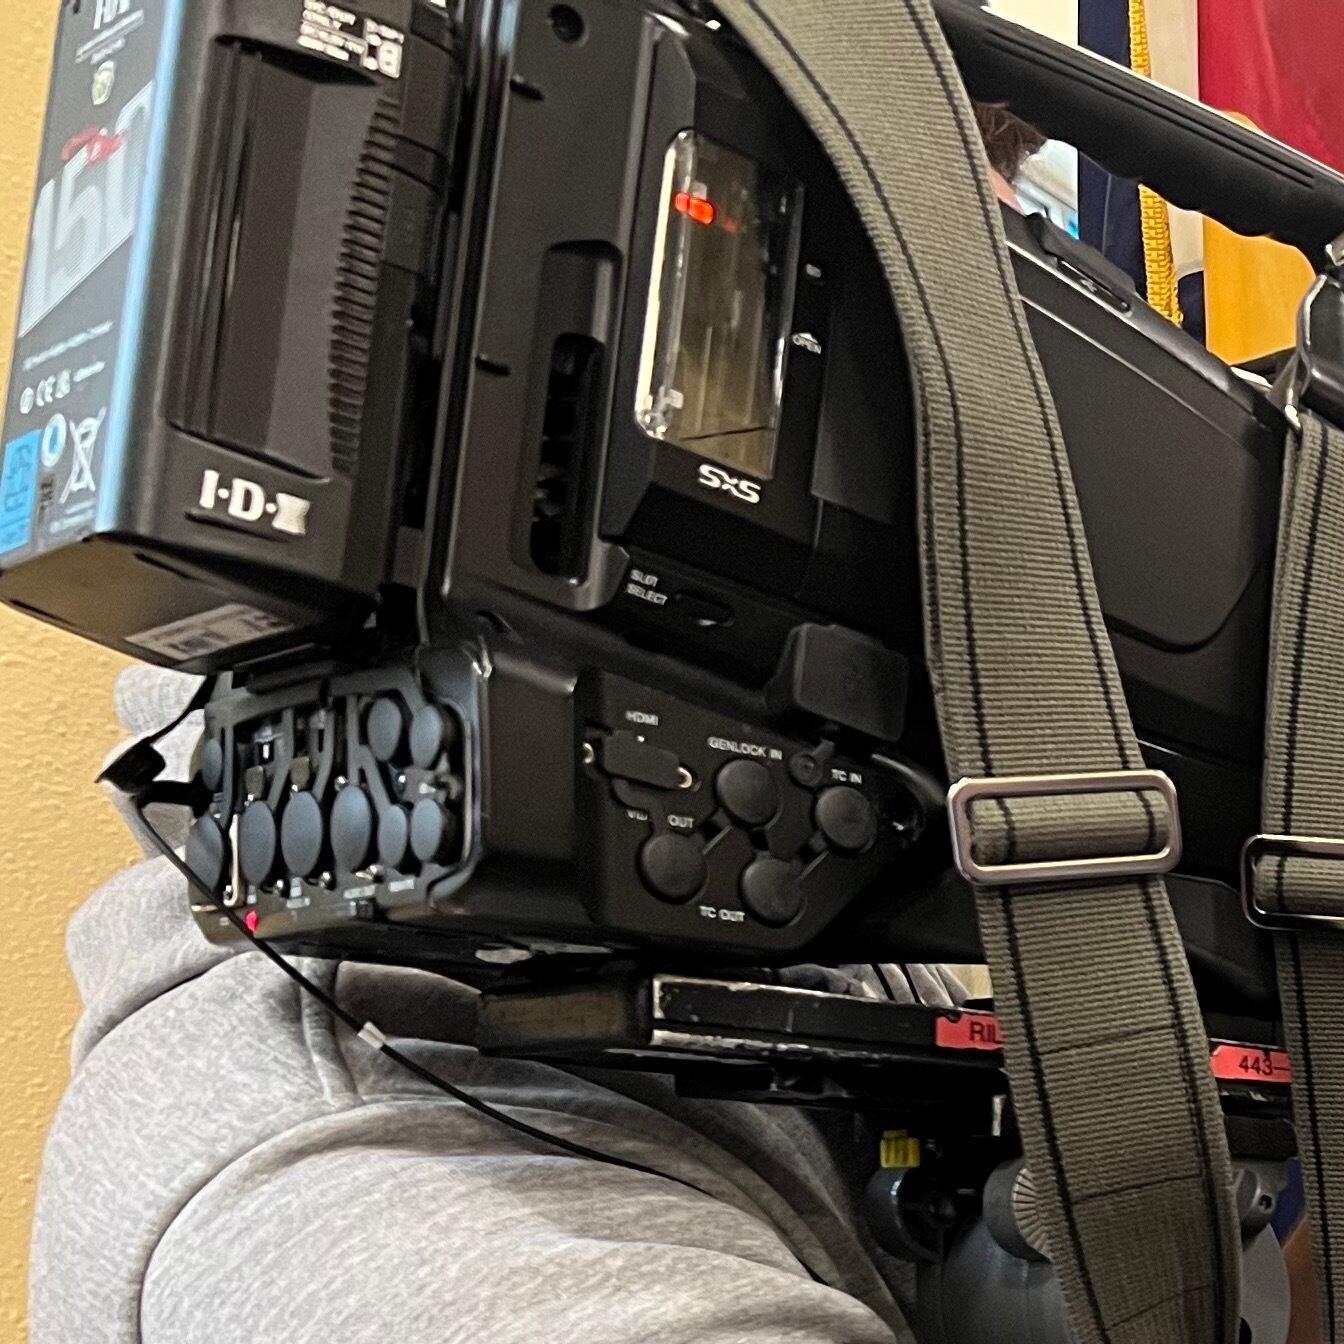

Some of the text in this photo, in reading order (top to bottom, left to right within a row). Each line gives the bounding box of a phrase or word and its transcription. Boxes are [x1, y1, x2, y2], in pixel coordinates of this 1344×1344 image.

[627, 583, 668, 605] SELECT
[625, 710, 659, 726] HDMI
[707, 736, 783, 760] GENLOCK IN
[831, 768, 862, 784] TC IN
[667, 814, 695, 829] OUT
[699, 905, 745, 922] TC OUT
